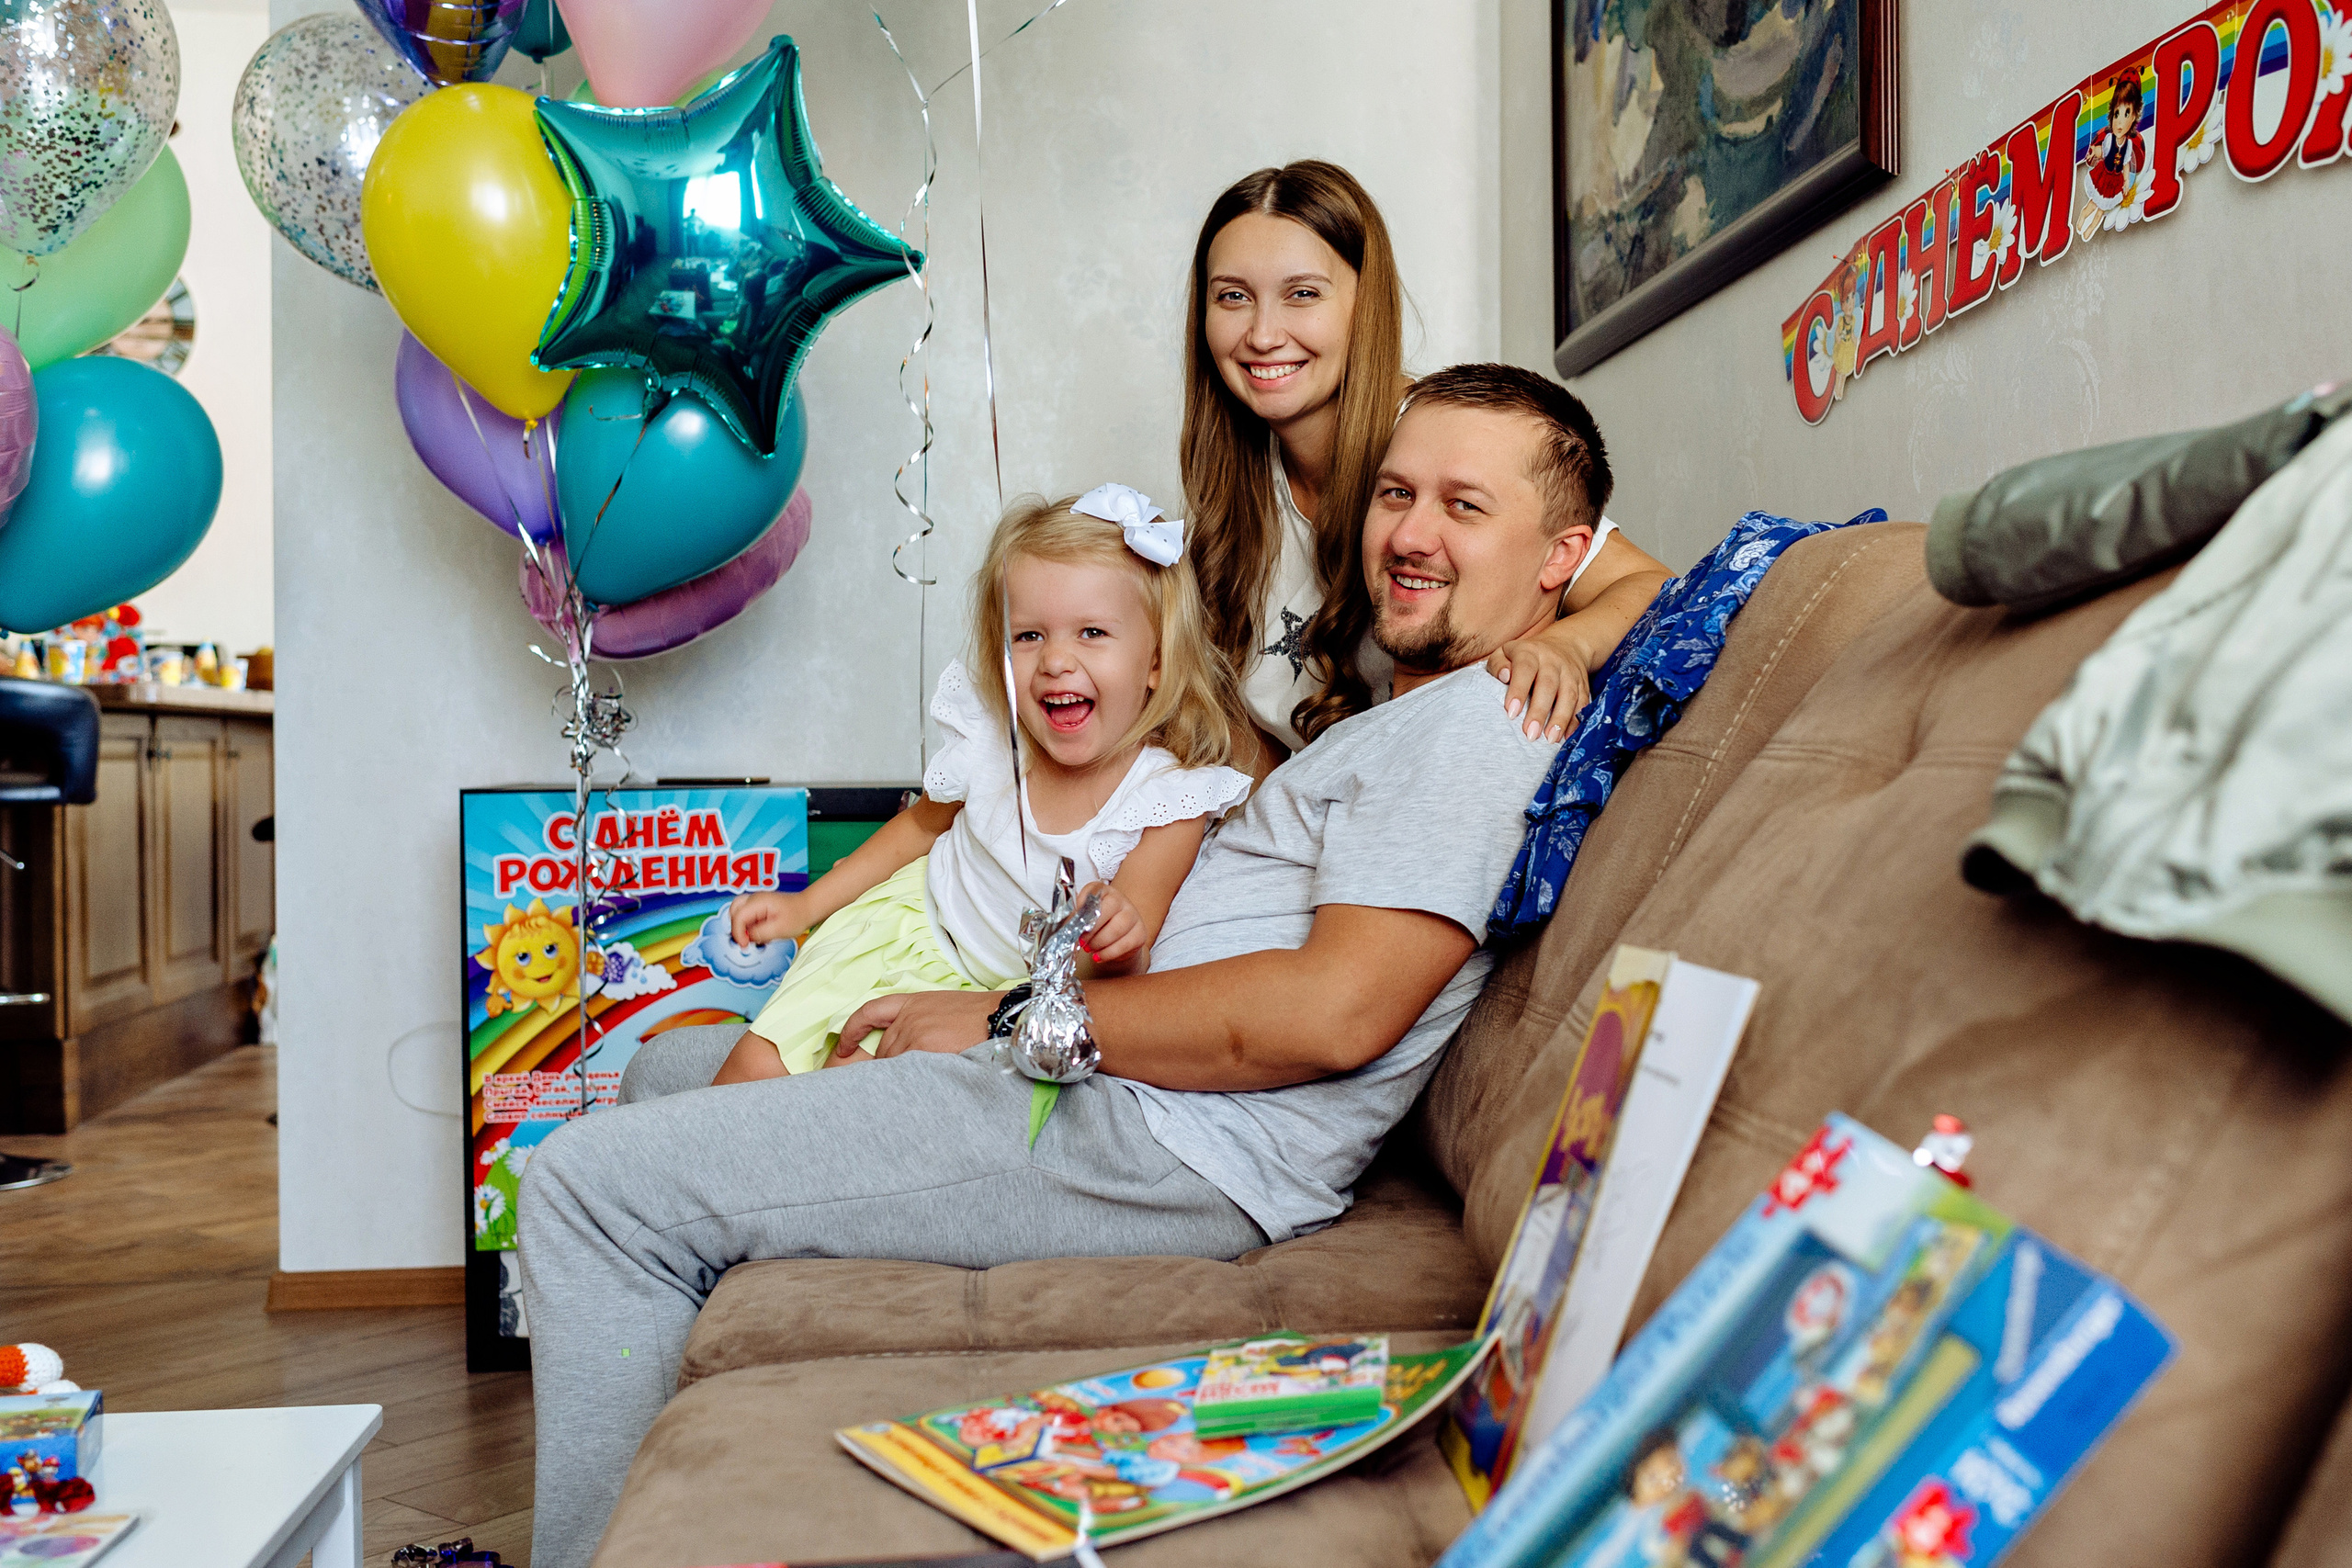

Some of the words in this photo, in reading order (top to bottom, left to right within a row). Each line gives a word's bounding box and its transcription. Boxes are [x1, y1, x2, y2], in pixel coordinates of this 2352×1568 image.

[1793, 291, 1836, 424] С
[1856, 90, 2083, 378] ДНЁМ
[548, 816, 575, 851] С
[594, 808, 726, 851] ДНЁМ
[499, 852, 776, 894] РОЖДЕНИЯ!
[564, 1071, 620, 1081] роденья
